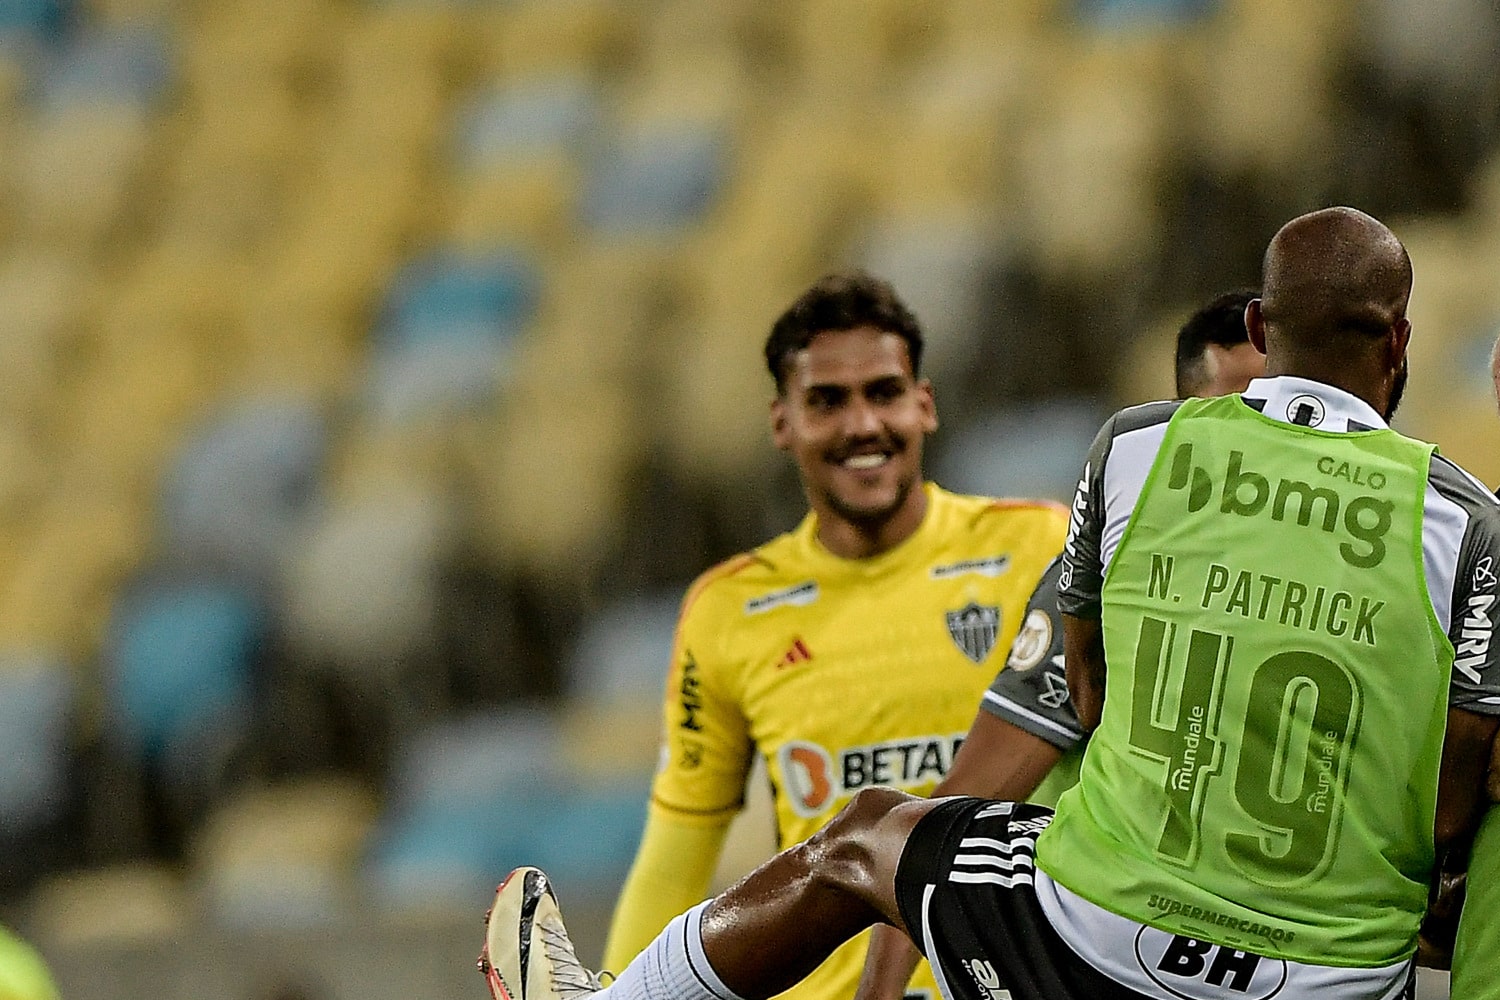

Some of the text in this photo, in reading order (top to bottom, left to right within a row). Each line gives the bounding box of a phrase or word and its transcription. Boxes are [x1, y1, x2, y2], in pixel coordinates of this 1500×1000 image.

[1220, 450, 1396, 569] bmg
[1316, 456, 1388, 491] GALO
[1147, 554, 1388, 648] N. PATRICK
[1453, 594, 1496, 686] MRV
[1128, 615, 1364, 888] 49
[1171, 705, 1204, 791] mundiale
[1306, 729, 1338, 814] mundiale
[1147, 894, 1297, 944] SUPERMERCADOS
[1156, 925, 1266, 993] BH
